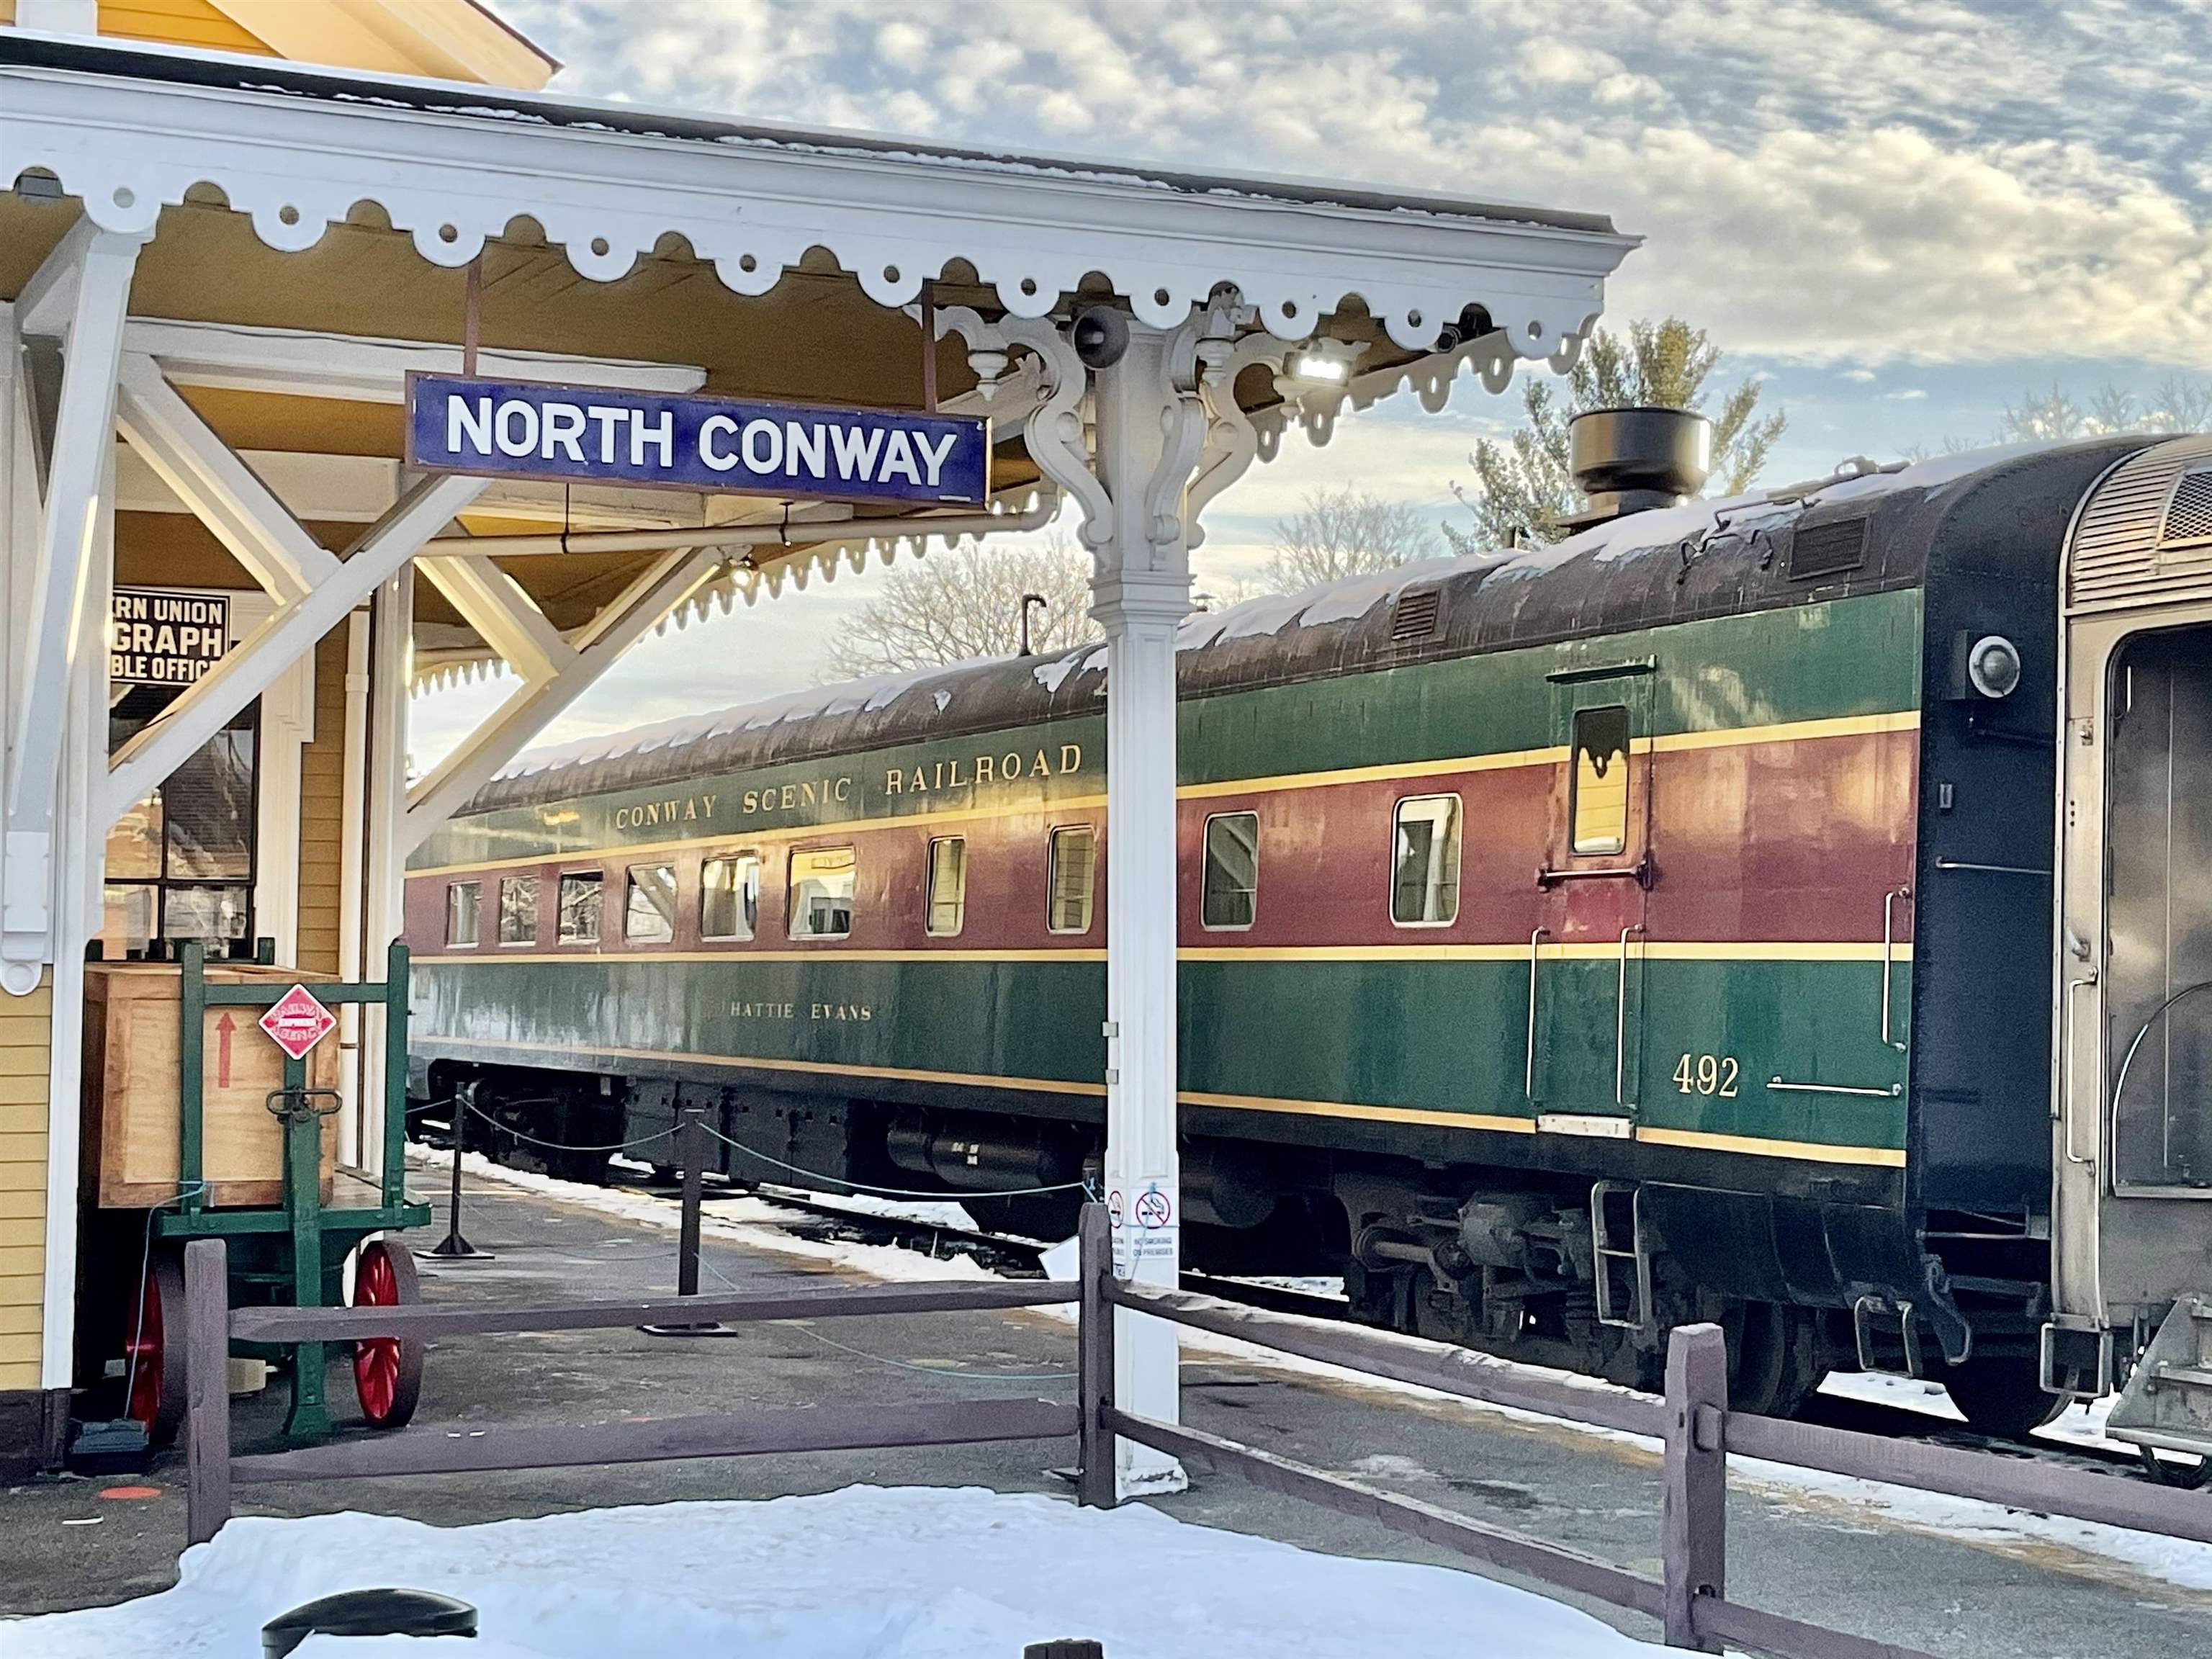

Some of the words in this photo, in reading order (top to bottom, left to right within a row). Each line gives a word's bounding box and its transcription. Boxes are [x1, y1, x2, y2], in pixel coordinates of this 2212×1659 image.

[446, 394, 673, 468] NORTH
[698, 415, 958, 487] CONWAY
[112, 596, 148, 620] RN
[153, 598, 223, 625] UNION
[151, 656, 219, 682] OFFIC
[616, 795, 717, 830] CONWAY
[742, 777, 852, 814] SCENIC
[885, 744, 1082, 795] RAILROAD
[730, 1002, 794, 1019] HATTIE
[811, 1003, 873, 1021] EVANS
[1672, 1053, 1739, 1097] 492
